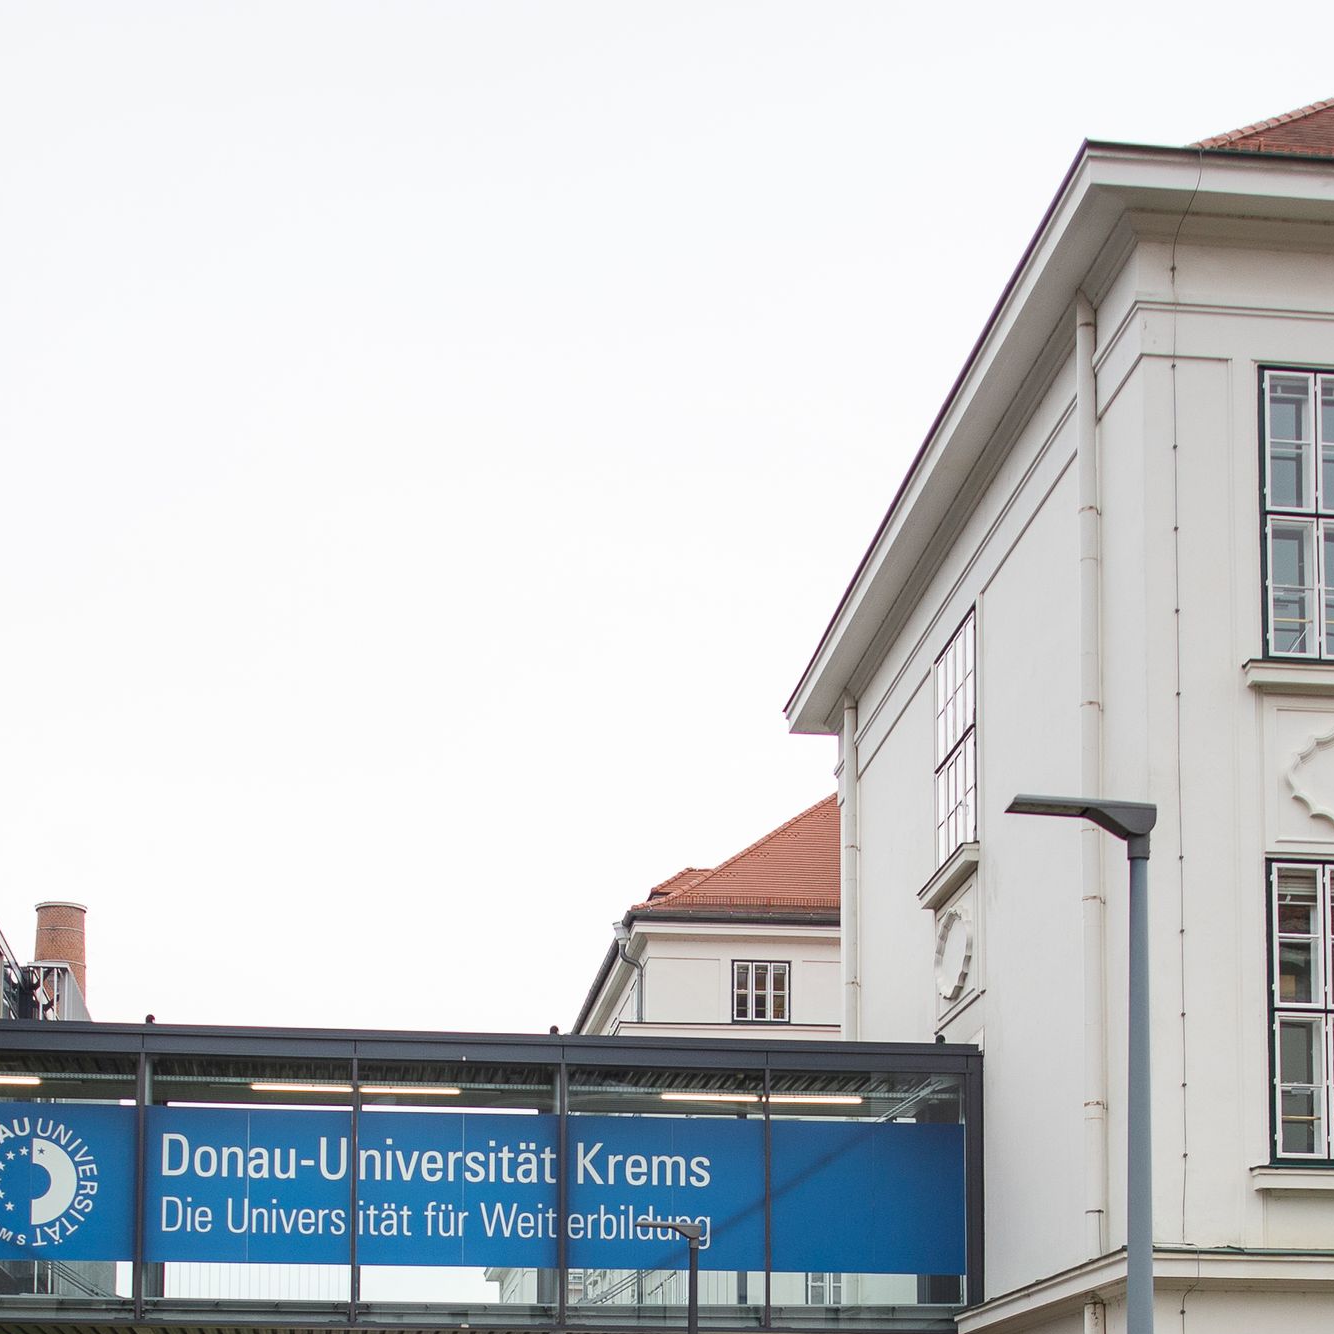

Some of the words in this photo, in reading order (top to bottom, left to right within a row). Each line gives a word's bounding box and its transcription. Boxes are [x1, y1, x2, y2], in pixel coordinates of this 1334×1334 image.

[32, 1118, 99, 1246] UNIVERSITÄT
[161, 1132, 557, 1184] Donau-Universität
[576, 1142, 711, 1188] Krems
[161, 1196, 213, 1233] Die
[227, 1197, 412, 1236] Universität
[424, 1201, 469, 1237] für
